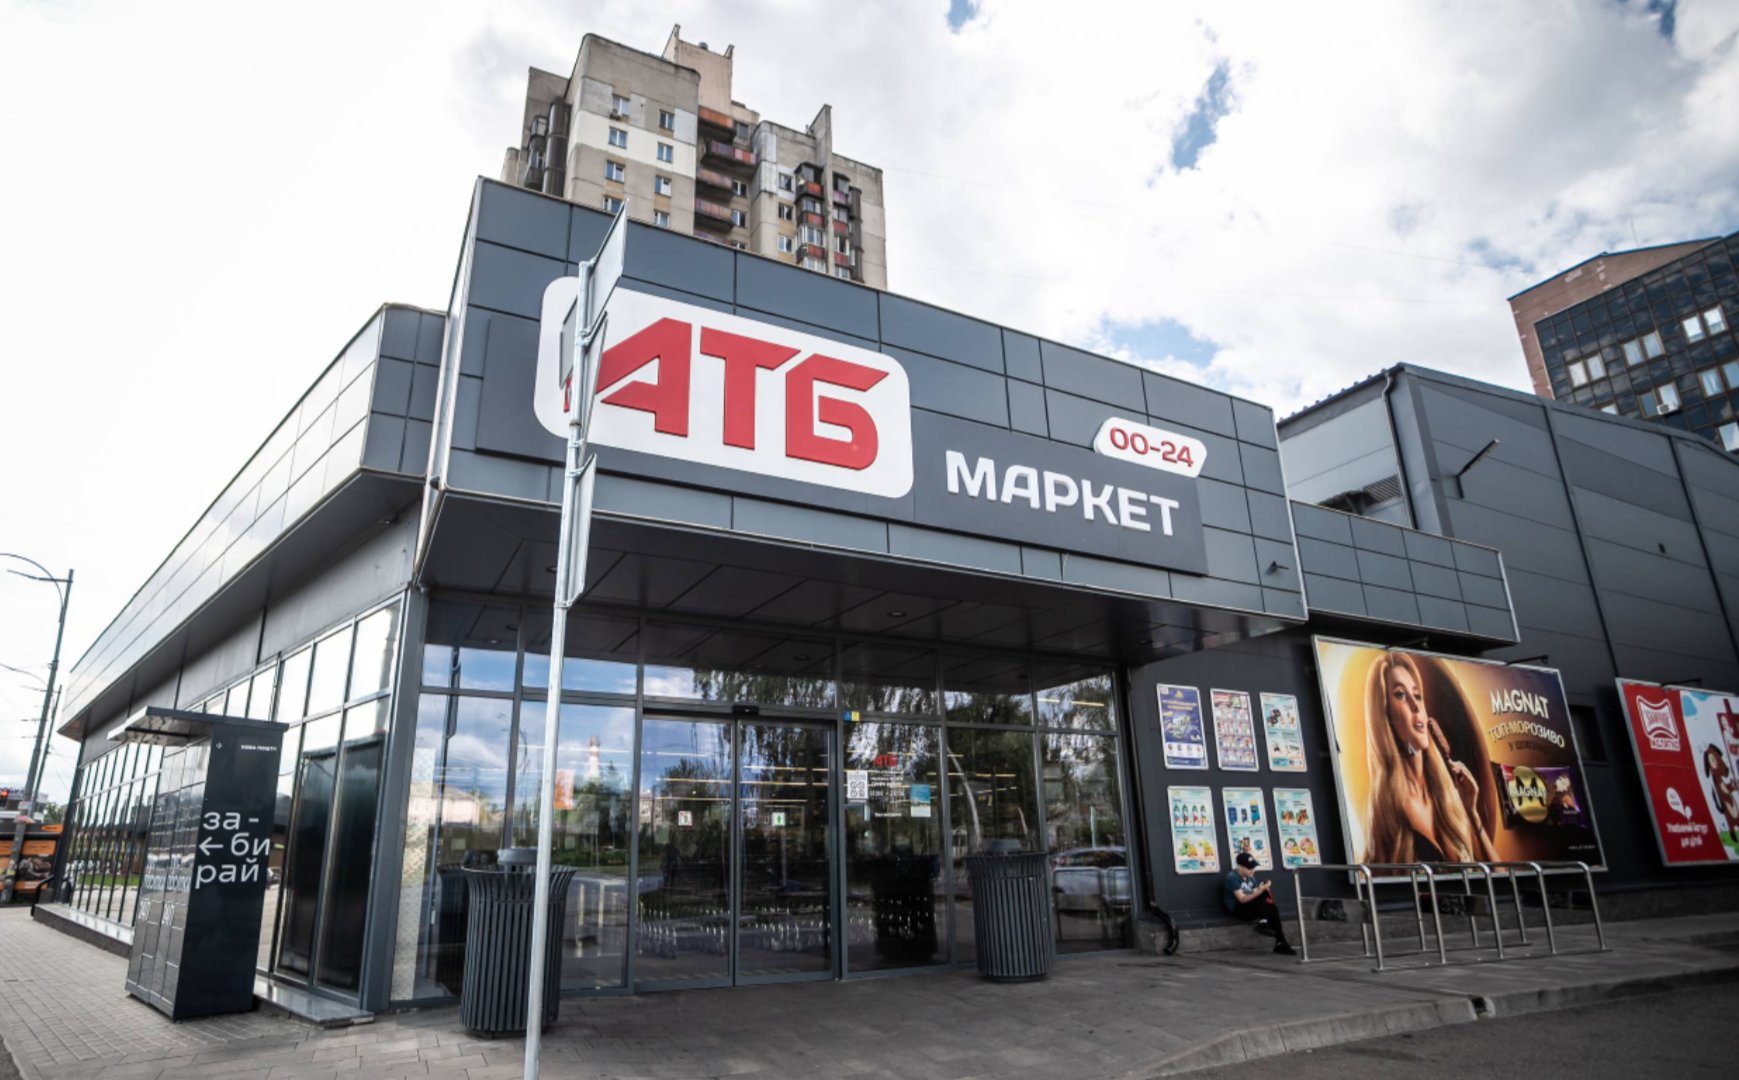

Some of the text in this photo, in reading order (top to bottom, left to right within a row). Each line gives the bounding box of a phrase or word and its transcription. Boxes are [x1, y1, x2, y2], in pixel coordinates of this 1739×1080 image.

[564, 317, 889, 471] АТБ
[1110, 427, 1194, 467] 00-24
[946, 450, 1180, 536] МАРКЕТ
[1490, 687, 1549, 719] MAGNAT
[1488, 720, 1565, 748] ТОП-МОРОЗИВО
[231, 832, 270, 856] би
[195, 857, 259, 889] рай
